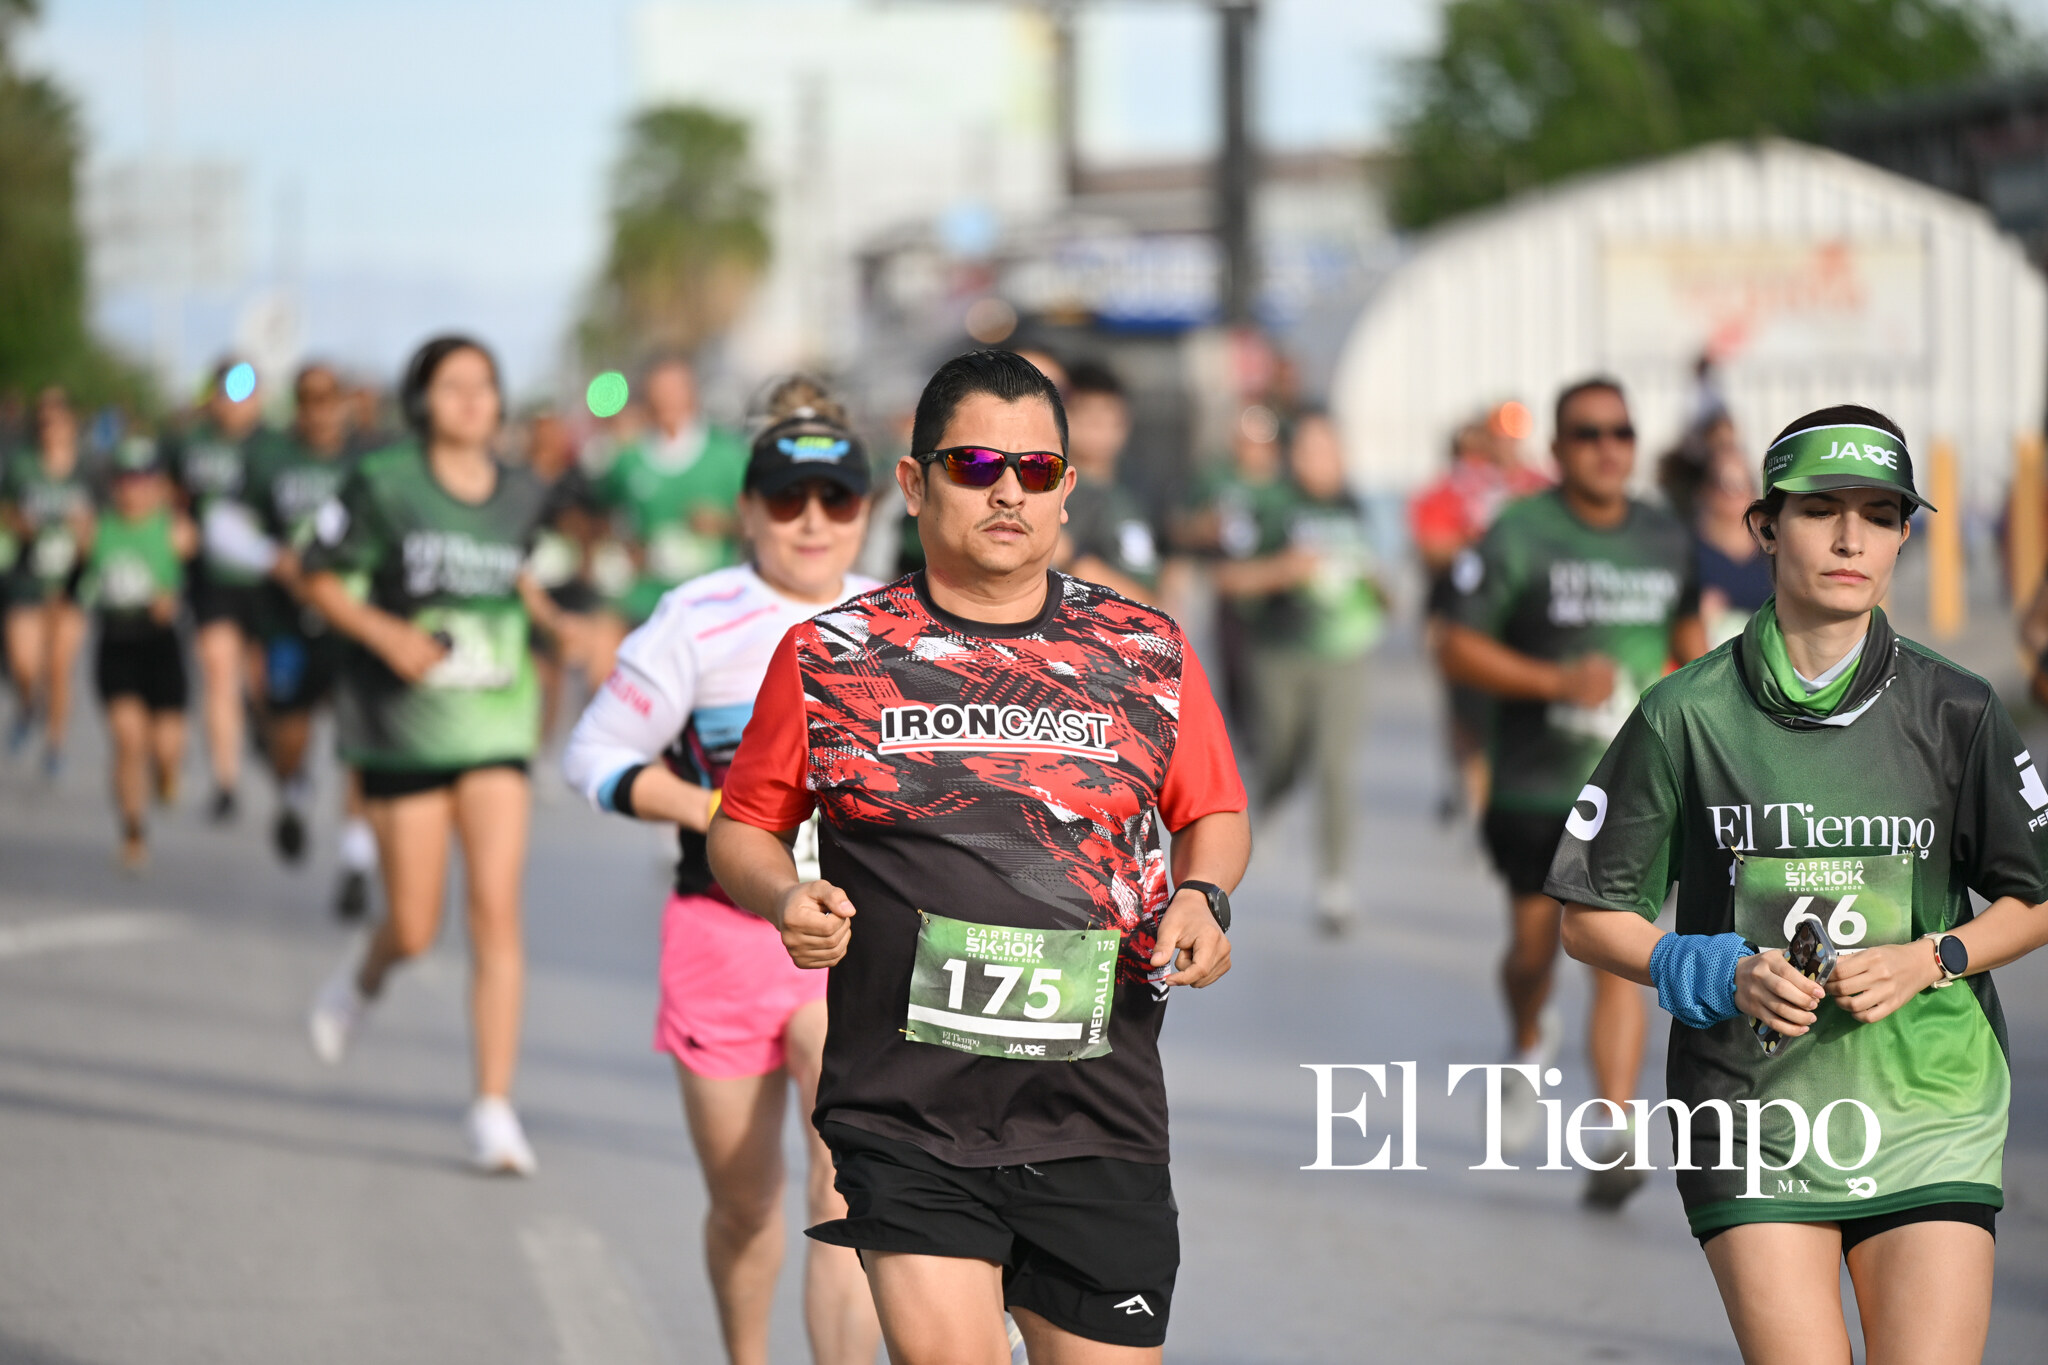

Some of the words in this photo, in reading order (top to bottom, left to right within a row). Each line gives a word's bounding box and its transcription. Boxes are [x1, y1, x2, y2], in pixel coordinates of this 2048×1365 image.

[881, 704, 1113, 748] IRONCAST
[1706, 804, 1758, 851] El
[1763, 802, 1936, 856] Tiempo
[1784, 860, 1864, 871] CARRERA
[967, 927, 1045, 943] CARRERA
[1783, 894, 1867, 946] 66
[1097, 940, 1116, 952] 175
[942, 958, 1062, 1020] 175
[1088, 960, 1111, 1044] MEDALLA
[942, 1030, 951, 1039] El
[951, 1032, 980, 1048] Tiempo
[952, 1040, 972, 1051] todos
